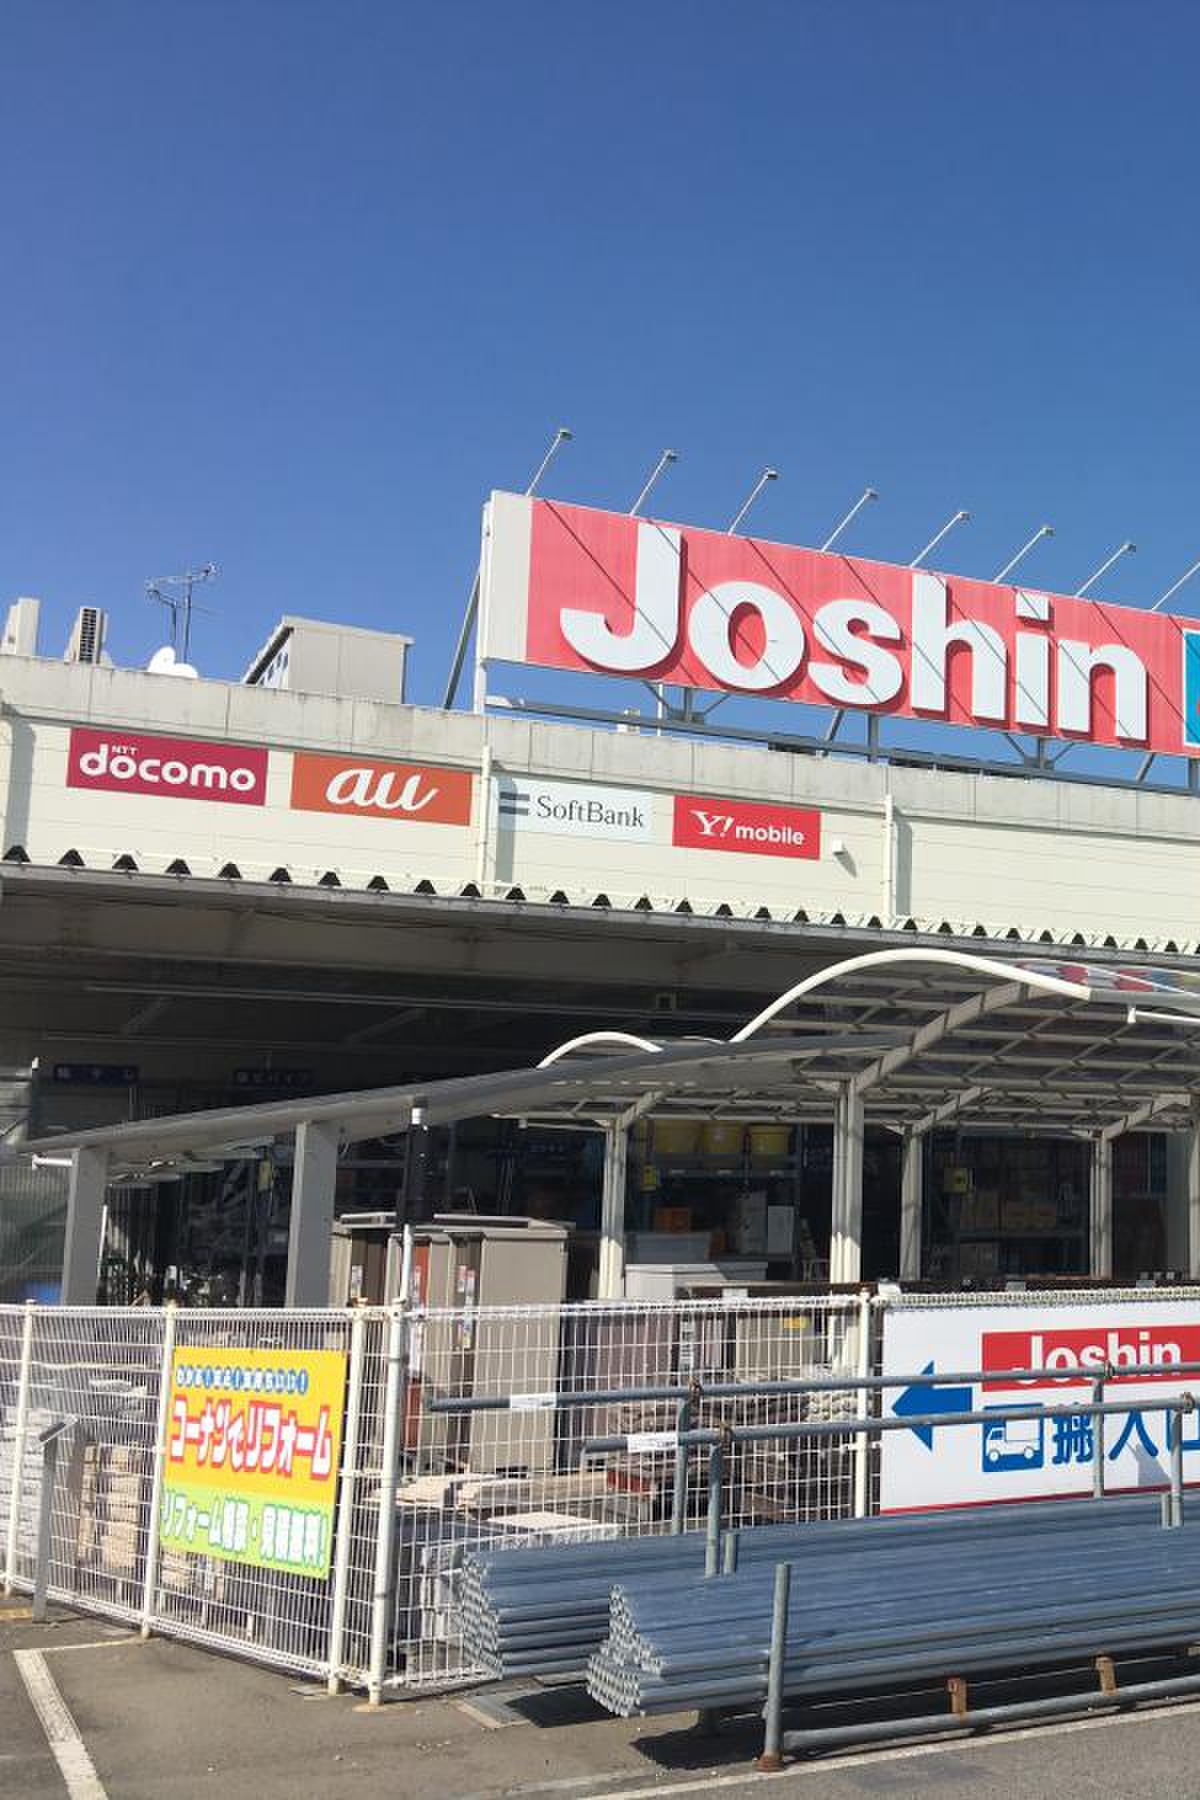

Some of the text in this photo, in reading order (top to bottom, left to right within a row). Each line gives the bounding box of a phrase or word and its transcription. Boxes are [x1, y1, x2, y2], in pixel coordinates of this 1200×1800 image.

[560, 522, 1149, 741] Joshin
[80, 743, 256, 791] docomo
[111, 745, 138, 756] NTT
[326, 768, 439, 811] au
[537, 796, 644, 828] SoftBank
[1011, 1331, 1182, 1385] Joshin
